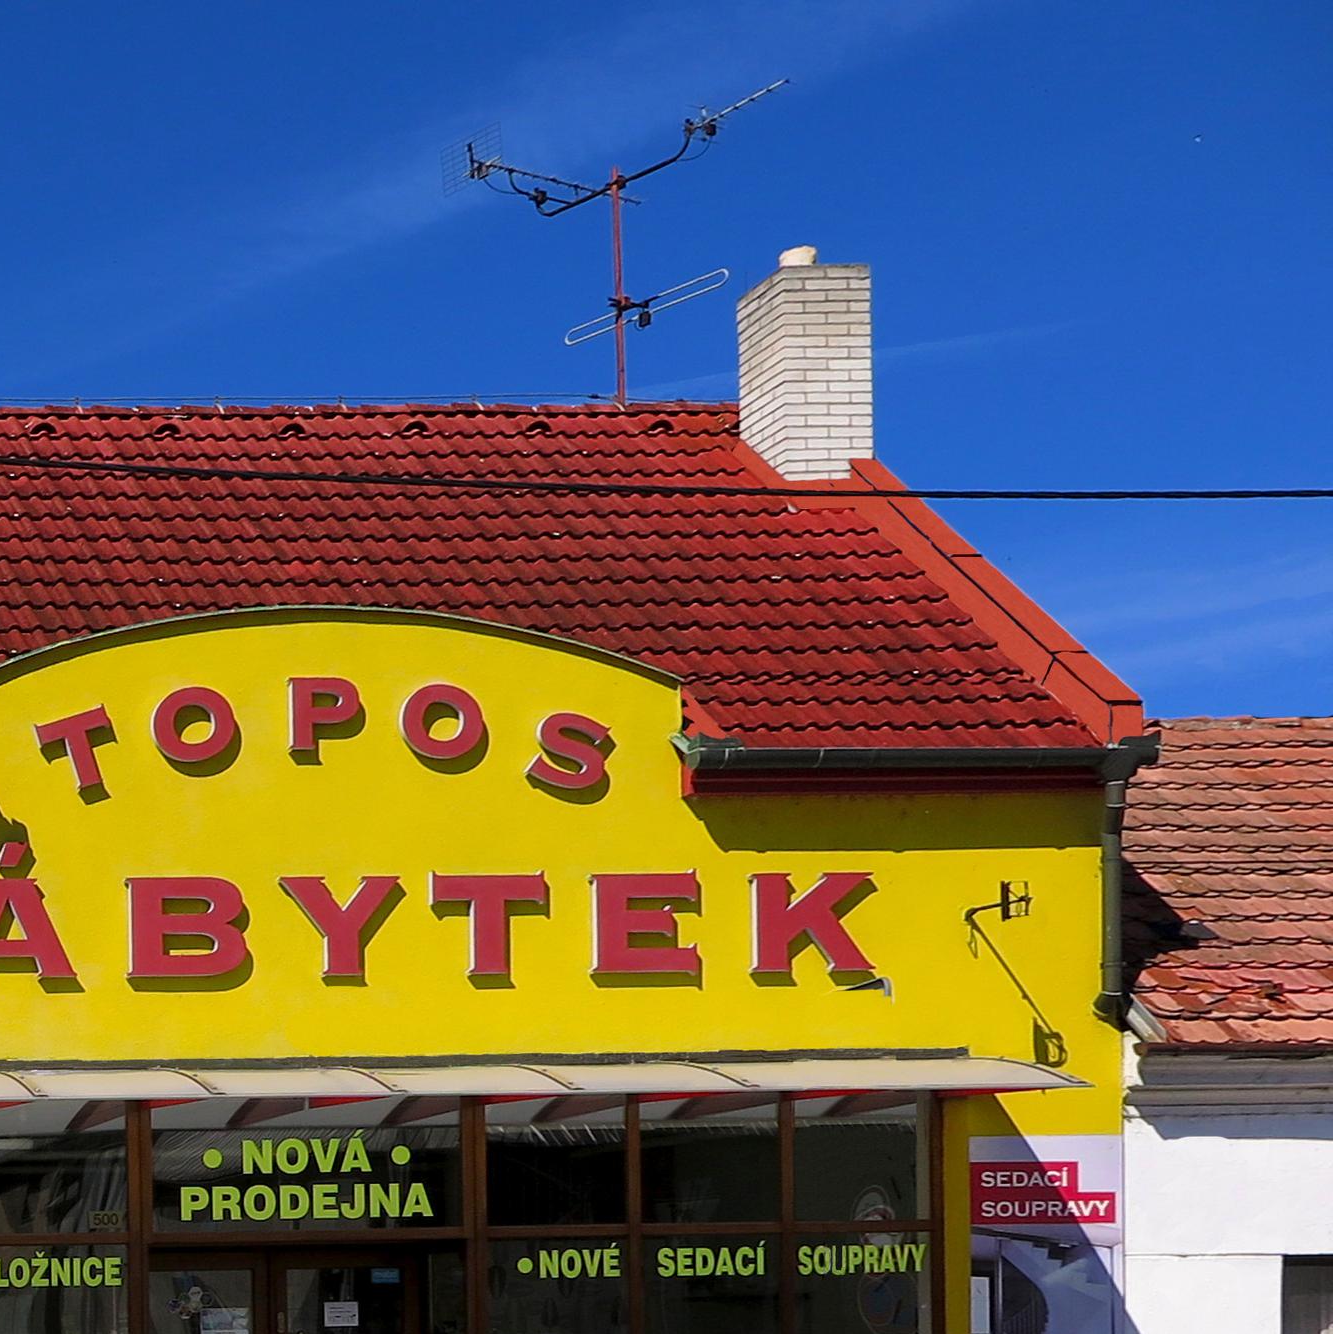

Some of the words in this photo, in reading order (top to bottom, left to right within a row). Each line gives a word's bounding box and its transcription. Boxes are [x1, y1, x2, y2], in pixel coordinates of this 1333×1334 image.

[34, 676, 612, 790] TOPOS
[242, 1129, 372, 1174] NOVÁ
[980, 1166, 1069, 1187] SEDACÍ
[93, 1212, 119, 1226] 500
[180, 1182, 434, 1221] PRODEJNA
[980, 1200, 1110, 1217] SOUPRAVY
[539, 1243, 622, 1279] NOVÉ
[657, 1240, 767, 1277] SEDACÍ
[797, 1243, 927, 1276] SOUPRAVY
